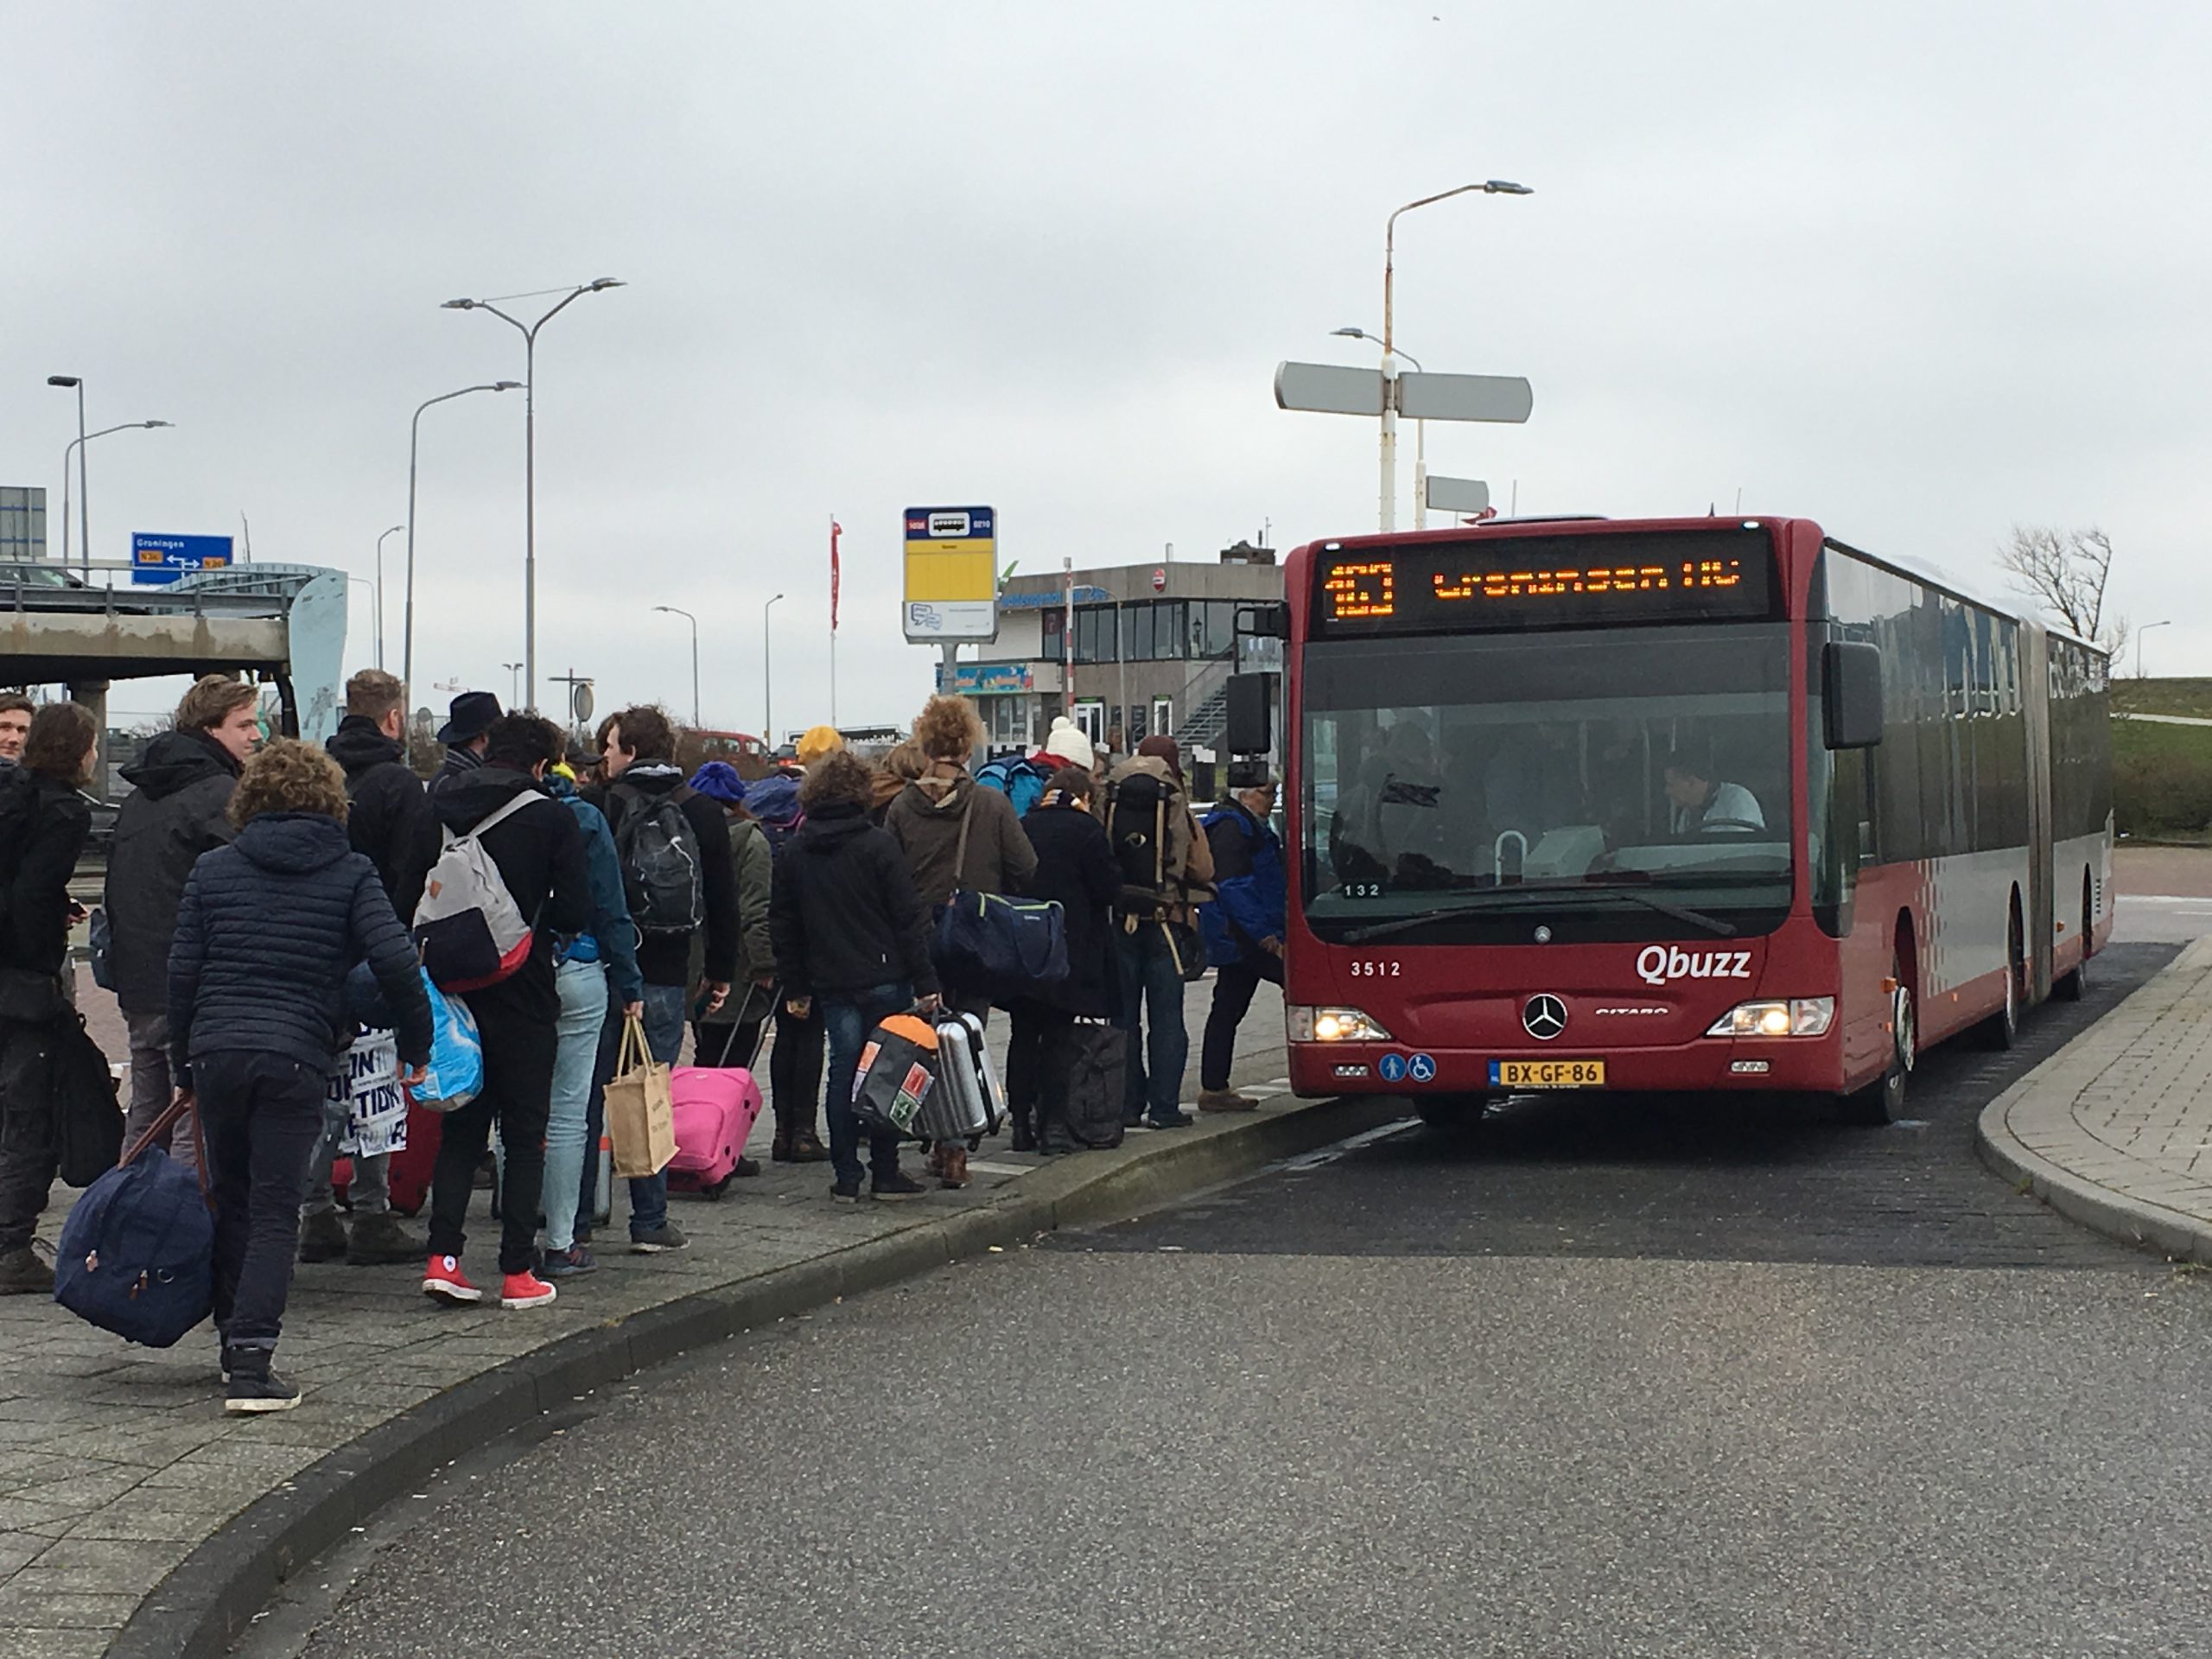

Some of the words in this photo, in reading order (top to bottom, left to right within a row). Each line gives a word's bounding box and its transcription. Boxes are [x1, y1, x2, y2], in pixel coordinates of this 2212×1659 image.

[137, 538, 185, 550] Groningen
[1351, 962, 1400, 976] 3512
[1637, 945, 1751, 984] Qbuzz
[1507, 1065, 1598, 1083] BX-GF-86
